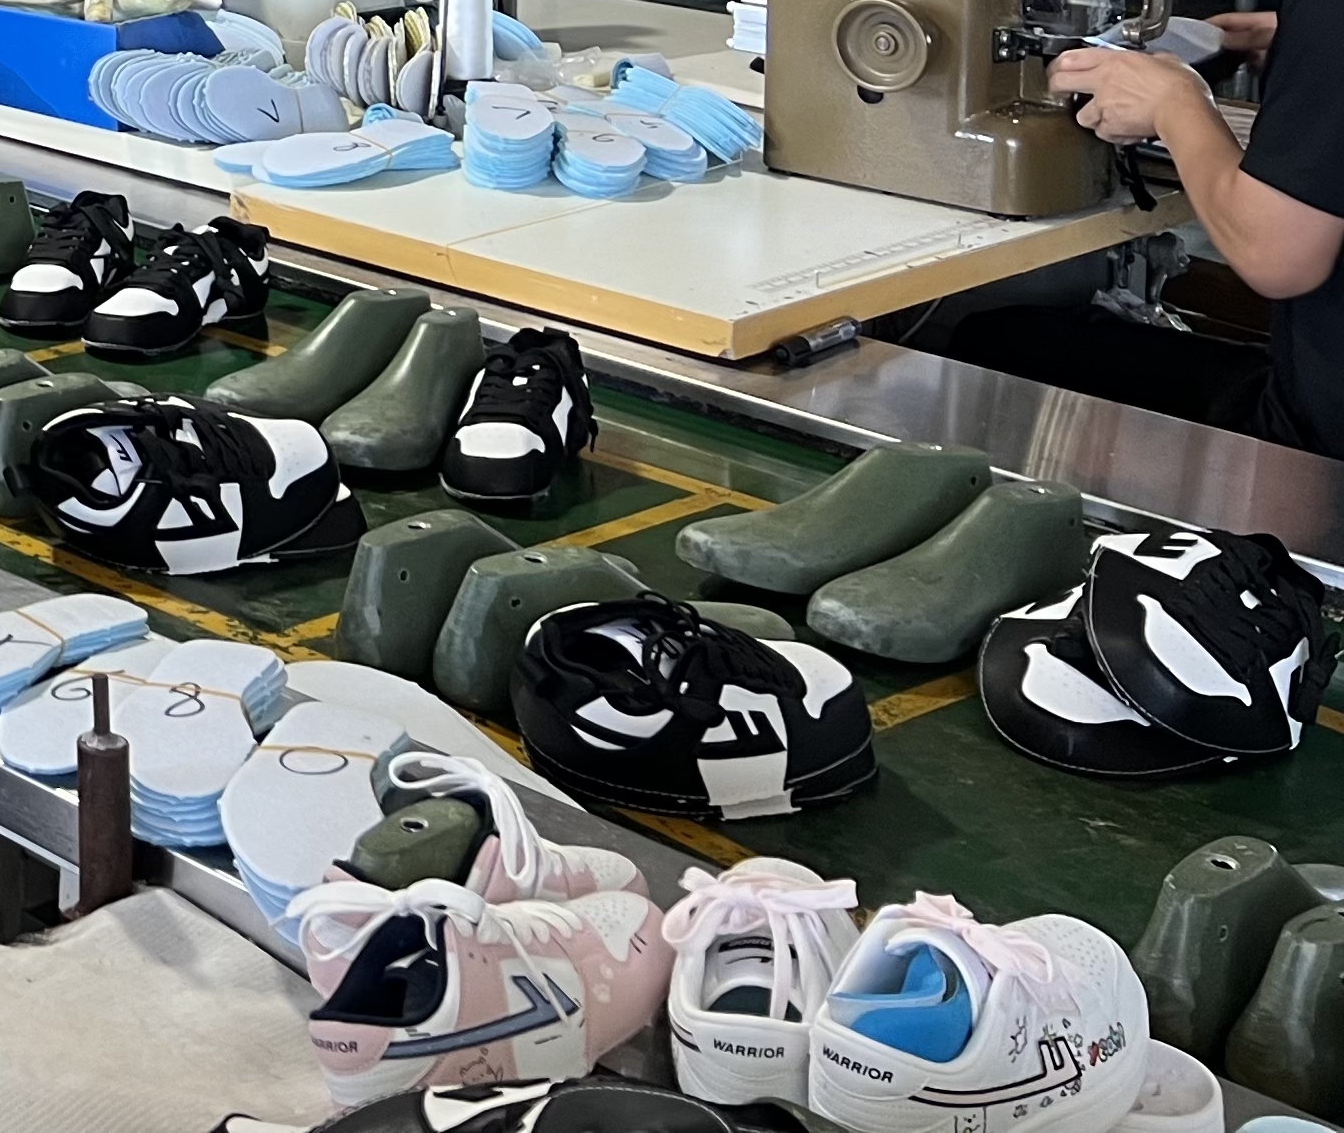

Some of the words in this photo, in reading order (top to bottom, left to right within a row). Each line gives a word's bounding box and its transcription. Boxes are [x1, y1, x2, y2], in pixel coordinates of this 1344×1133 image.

[164, 681, 206, 718] 8
[279, 746, 349, 776] 0
[713, 1037, 785, 1059] WARRIOR
[823, 1043, 894, 1083] WARRIOR
